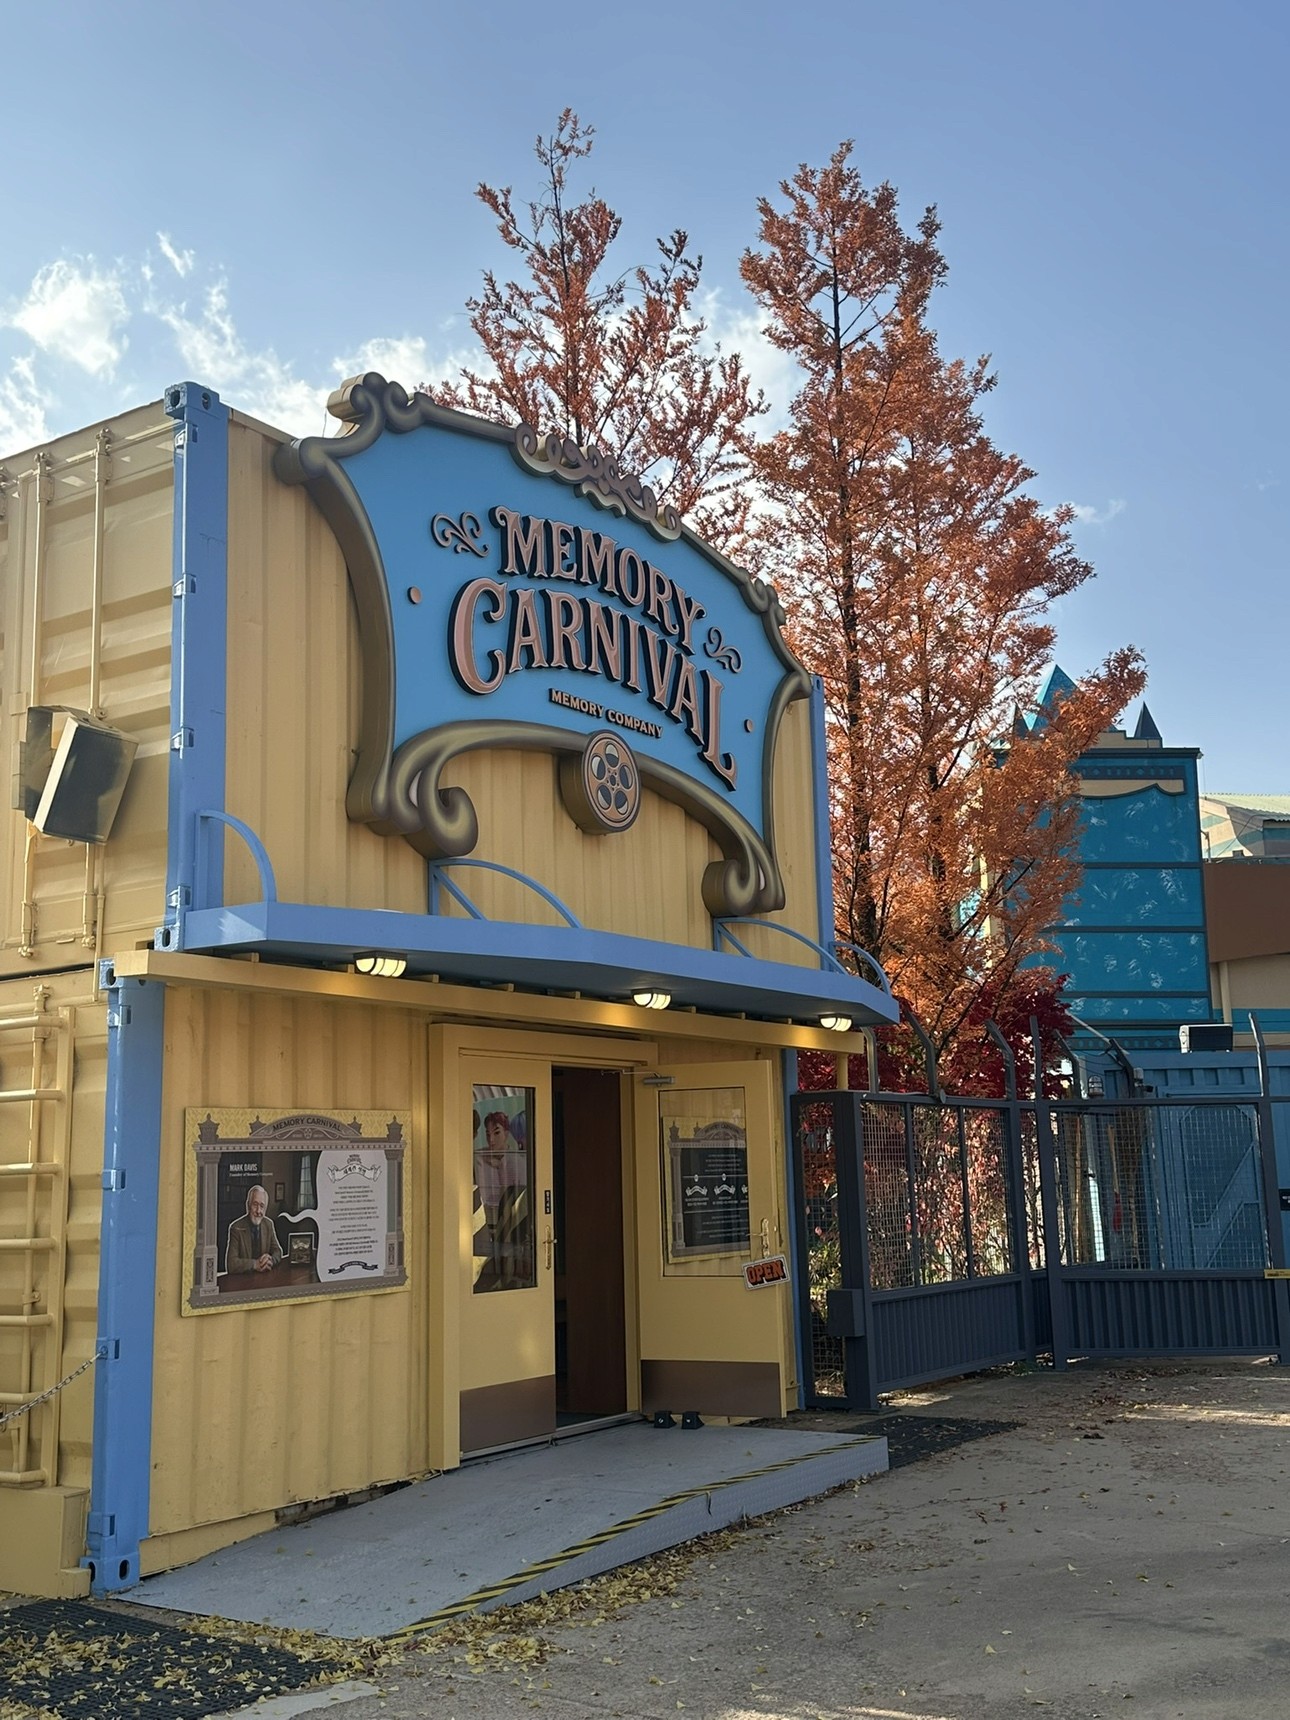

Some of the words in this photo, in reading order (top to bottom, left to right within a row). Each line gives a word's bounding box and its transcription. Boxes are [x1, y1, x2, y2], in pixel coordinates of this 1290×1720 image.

[489, 506, 706, 655] MEMORY
[448, 577, 737, 791] CARNIVAL
[549, 688, 604, 718] MEMORY
[605, 709, 663, 738] COMPANY
[272, 1117, 304, 1132] MEMORY
[306, 1117, 341, 1132] CARNIVAL
[229, 1163, 243, 1171] MARK
[746, 1260, 786, 1285] OPEN
